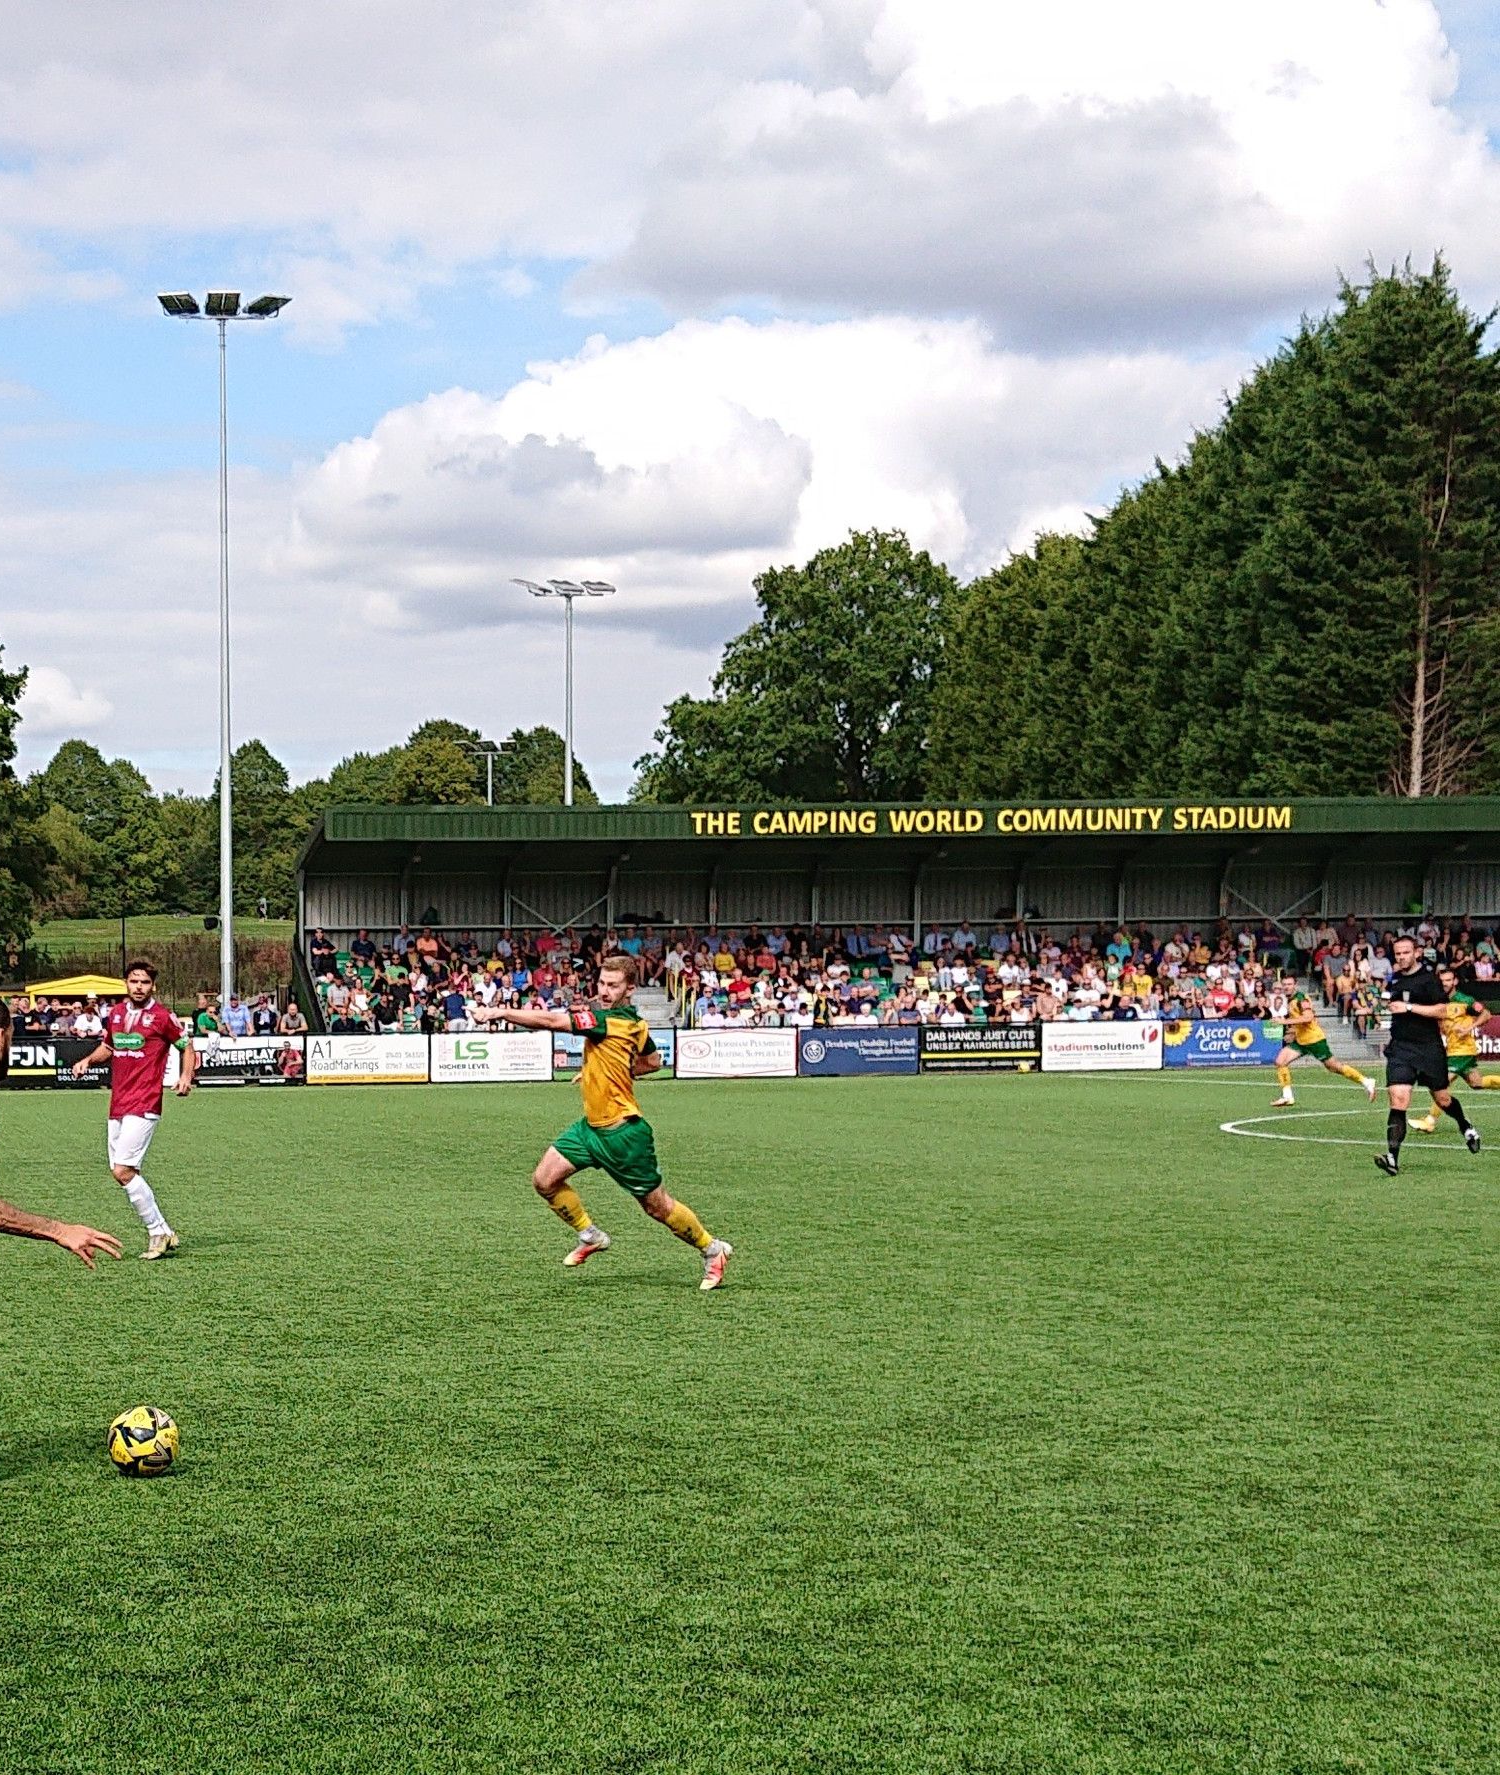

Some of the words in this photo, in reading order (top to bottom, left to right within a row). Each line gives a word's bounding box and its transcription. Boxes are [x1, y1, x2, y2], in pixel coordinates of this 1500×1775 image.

[691, 811, 741, 835] THE
[753, 810, 877, 834] CAMPING
[889, 809, 984, 833] WORLD
[997, 808, 1164, 832] COMMUNITY
[1173, 807, 1291, 830] STADIUM
[926, 1031, 946, 1042] DAB
[948, 1031, 982, 1041] HANDS
[983, 1030, 1007, 1041] JUST
[1008, 1030, 1036, 1040] CUTS
[1195, 1025, 1232, 1040] Ascot
[311, 1040, 333, 1059] A1
[926, 1042, 961, 1051] UNISEX
[963, 1040, 1036, 1050] HAIRDRESSERS
[1047, 1042, 1145, 1052] stadiumsolutions
[1199, 1038, 1231, 1052] Care
[57, 1067, 109, 1075] RECTMENT
[57, 1074, 100, 1082] SOLUONS
